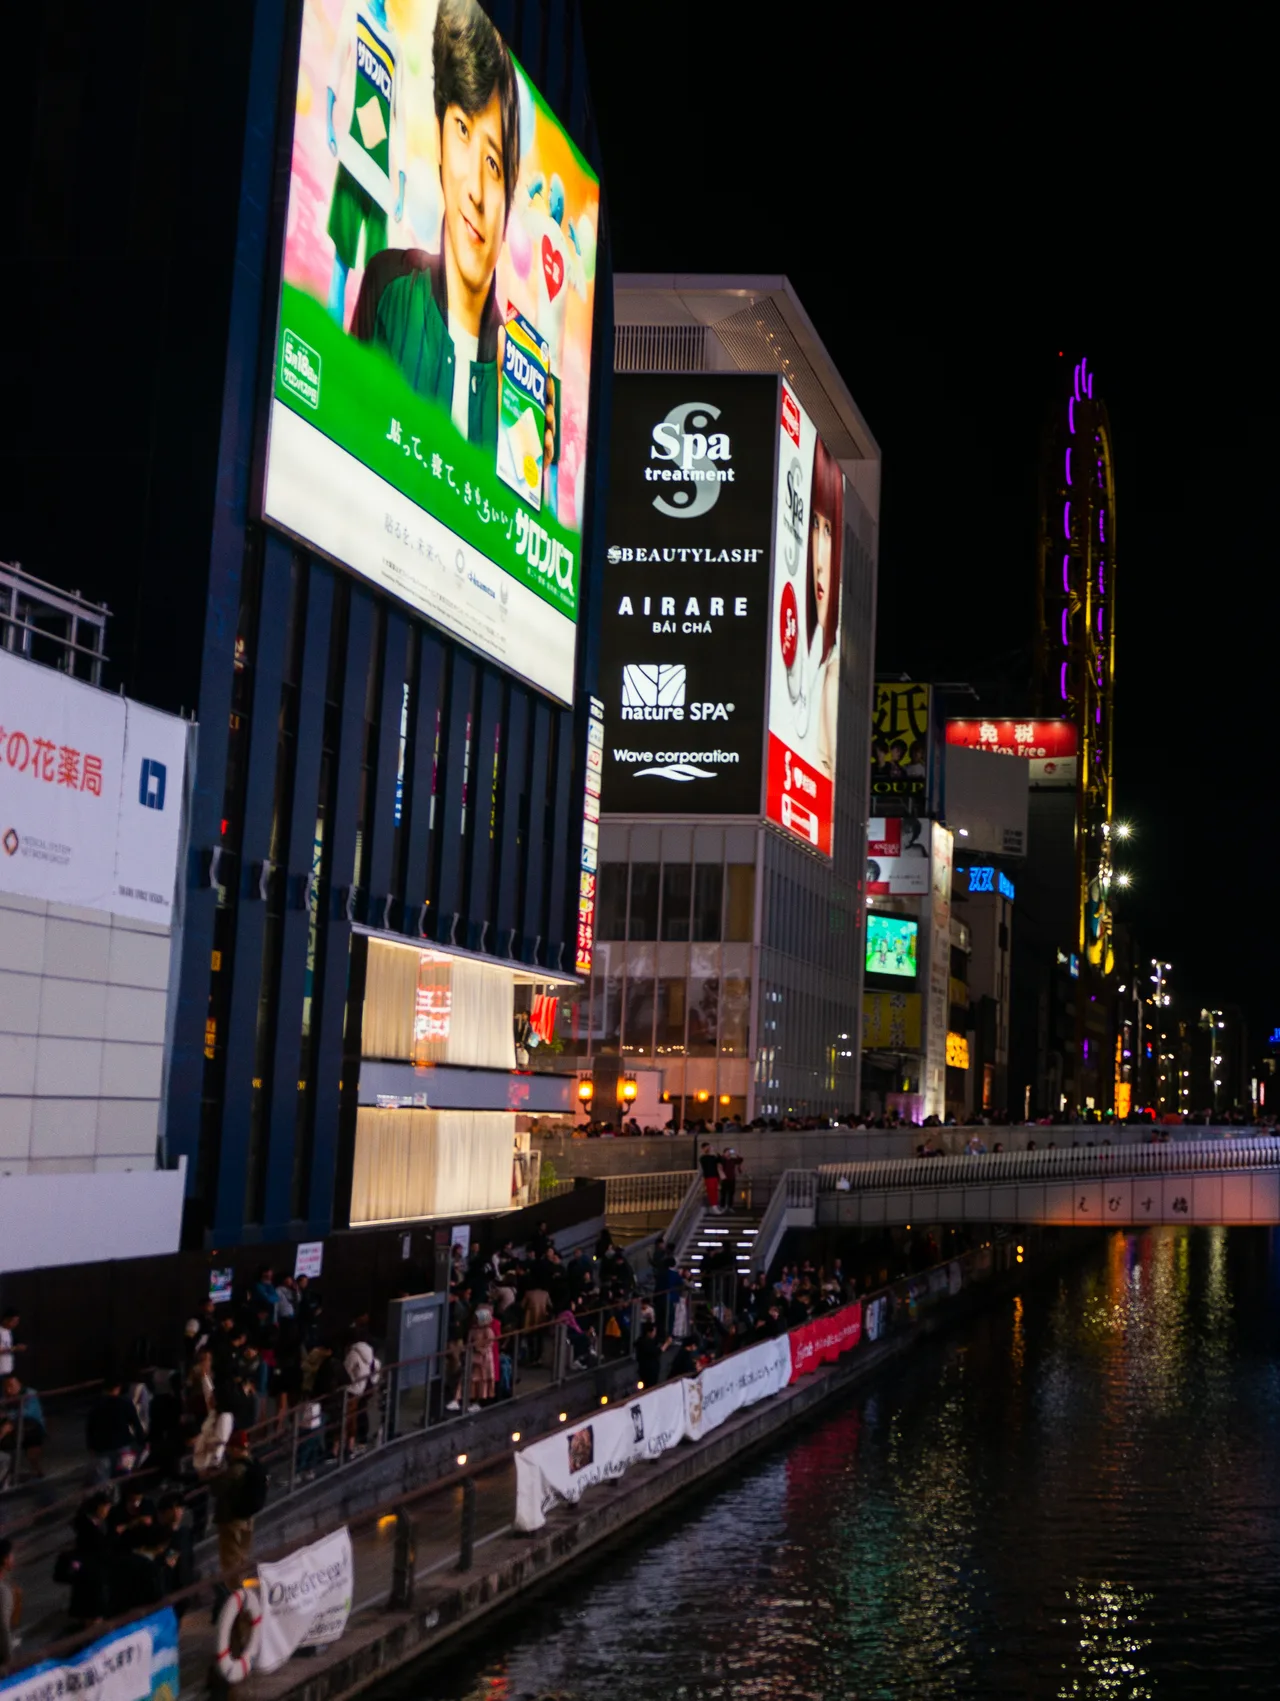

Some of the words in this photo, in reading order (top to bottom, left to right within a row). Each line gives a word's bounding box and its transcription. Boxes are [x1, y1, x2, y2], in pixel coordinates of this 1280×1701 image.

[506, 340, 546, 405] サロンパス
[651, 422, 731, 470] Spa
[645, 466, 734, 482] treatment
[515, 508, 575, 598] サロンパス
[618, 596, 748, 616] AIRARE
[653, 621, 676, 633] BÁI
[682, 621, 712, 633] CHÁ
[621, 706, 684, 720] nature
[690, 703, 729, 721] SPA
[980, 724, 1034, 743] 免税
[614, 749, 650, 763] Wave
[655, 749, 739, 764] corporation
[1018, 744, 1046, 757] Free
[0, 726, 103, 796] の花薬局
